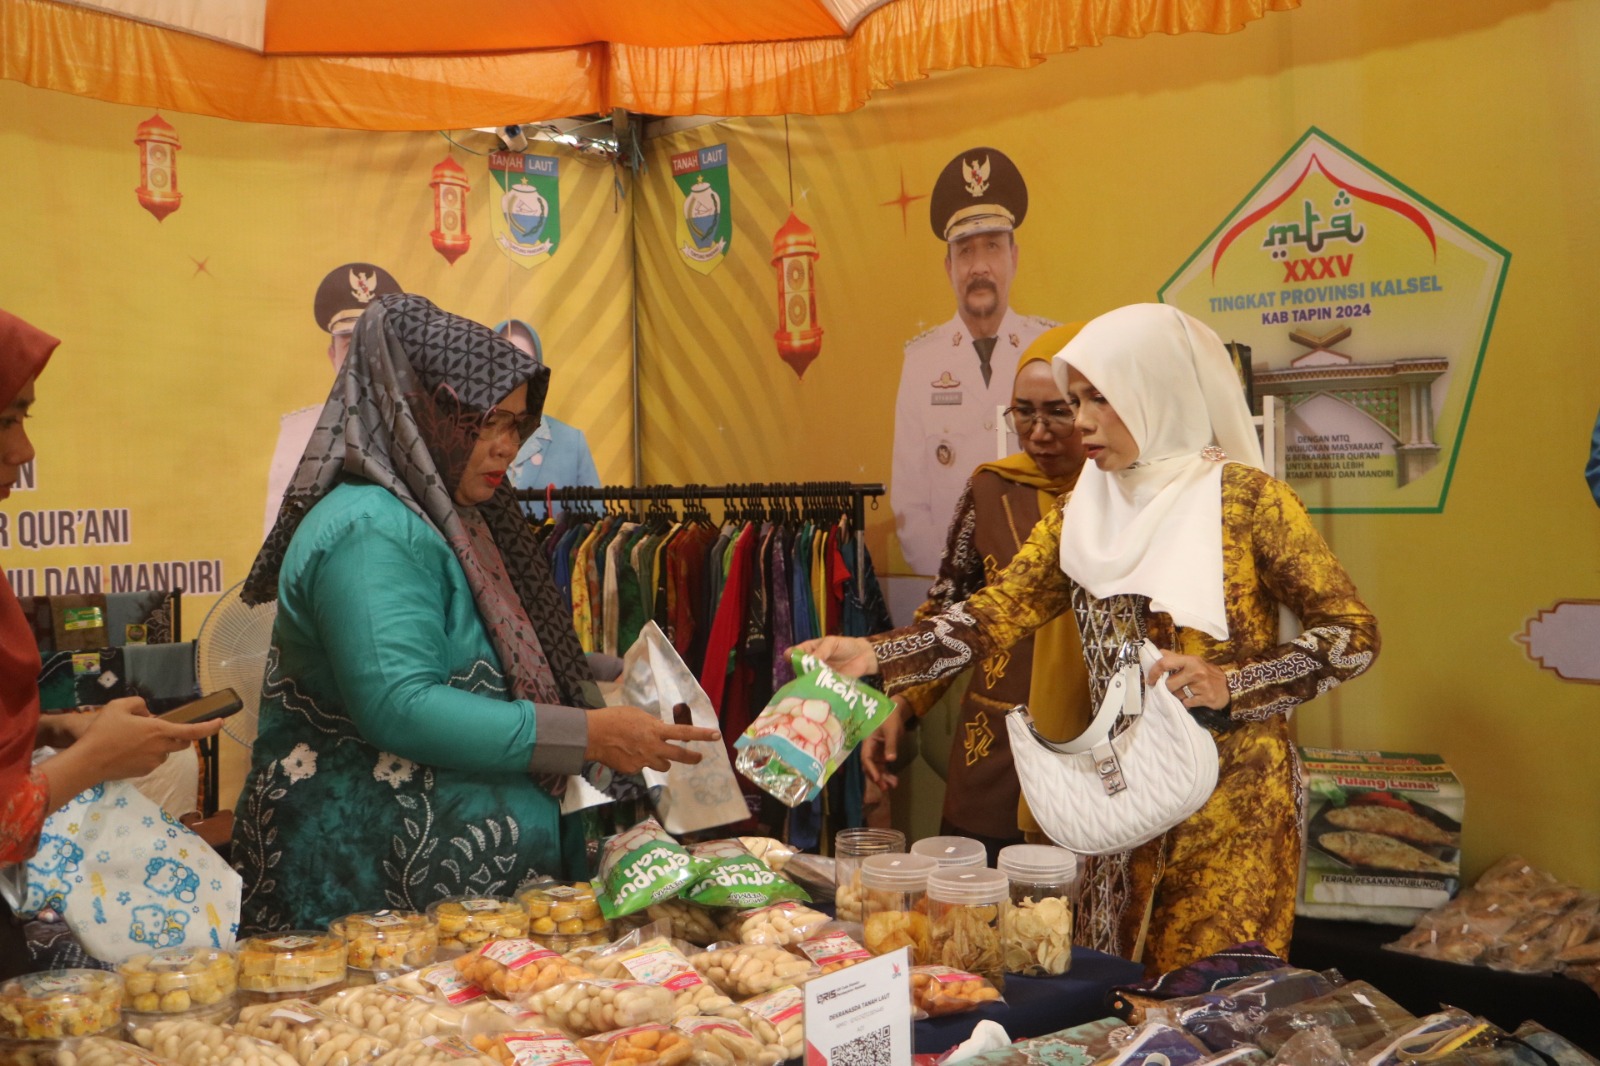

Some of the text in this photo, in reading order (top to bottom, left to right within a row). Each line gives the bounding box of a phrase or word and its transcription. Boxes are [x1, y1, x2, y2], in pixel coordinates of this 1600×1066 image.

[491, 154, 554, 172] TANAH LAUT
[672, 149, 723, 171] TANAH LAUT
[1283, 254, 1354, 283] XXXV
[1209, 275, 1443, 313] TINGKAT PROVINSI KALSEL
[1261, 303, 1371, 325] KAB TAPIN 2024
[1297, 434, 1350, 443] DENGAN MTQ
[1331, 442, 1383, 451] MASYARAKAT
[1347, 452, 1380, 460] QUR'ANI
[1313, 462, 1340, 470] BANUA
[1342, 461, 1364, 469] LEBIH
[1315, 471, 1337, 479] MAJU
[1338, 470, 1355, 478] DAN
[1357, 469, 1394, 478] MANDIRI
[18, 509, 129, 548] QUR'ANI
[45, 566, 100, 596] DAN
[110, 560, 222, 594] MANDIRI
[1336, 776, 1386, 789] Tulang
[1389, 778, 1437, 791] Lunak
[1321, 875, 1353, 884] TERIMA
[1355, 876, 1395, 886] PESANAN
[1398, 878, 1440, 889] HUBUNGI
[816, 990, 837, 1005] QRIS
[861, 996, 878, 1009] TANAH
[878, 992, 890, 1004] LAUT
